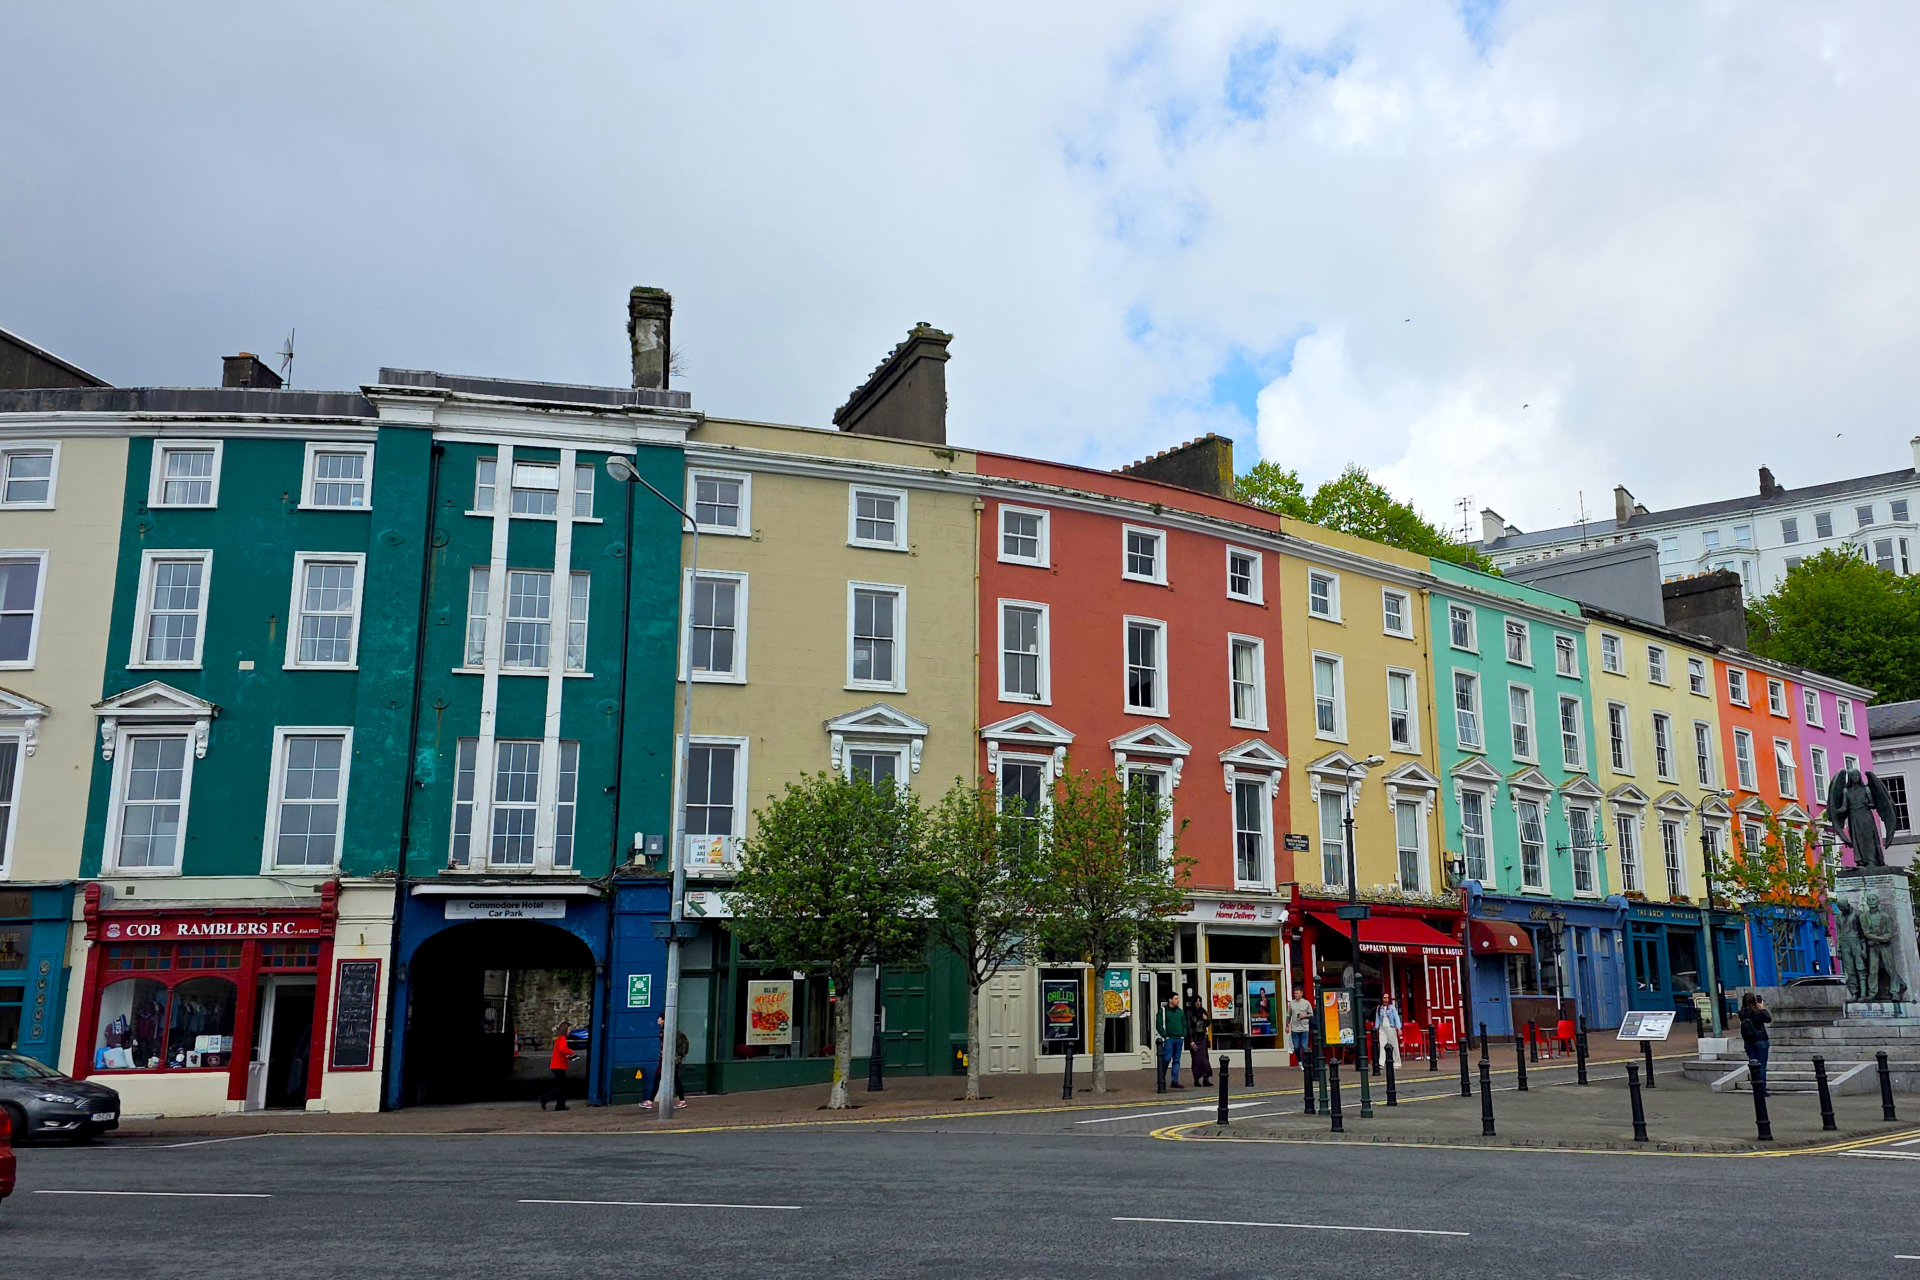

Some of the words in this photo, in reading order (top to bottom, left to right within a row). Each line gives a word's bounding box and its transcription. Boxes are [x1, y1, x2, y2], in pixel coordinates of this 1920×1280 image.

[521, 901, 544, 909] Hotel
[1220, 902, 1236, 910] Order
[1237, 903, 1256, 911] Online
[1215, 911, 1233, 919] Home
[1233, 912, 1257, 921] Delivery
[1649, 909, 1664, 918] ARCH
[126, 924, 161, 936] COB
[177, 922, 268, 936] RAMBLERS
[1389, 945, 1407, 953] COFFEE
[1422, 946, 1439, 955] COFFEE
[1445, 948, 1463, 956] BAGELS
[754, 992, 787, 1004] MYSELF
[1048, 990, 1074, 1002] GRILLED
